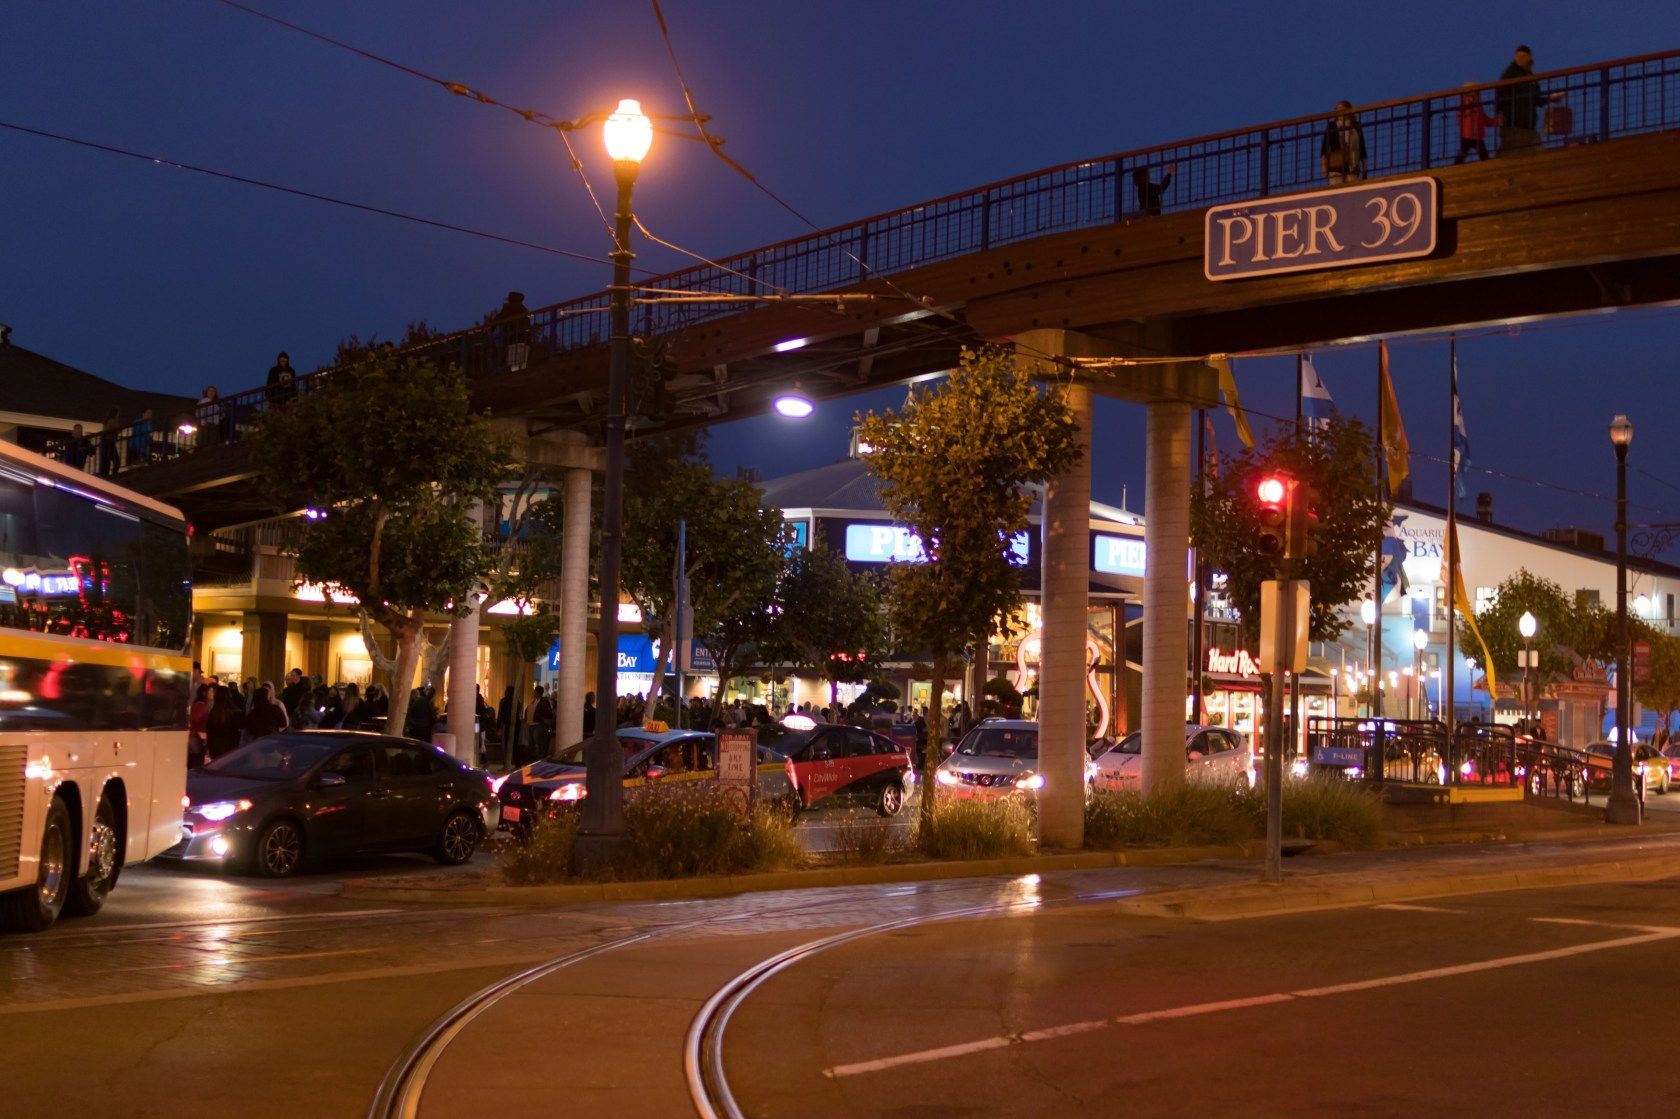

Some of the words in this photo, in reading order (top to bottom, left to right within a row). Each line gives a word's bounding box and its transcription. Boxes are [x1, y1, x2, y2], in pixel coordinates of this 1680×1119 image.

[1216, 204, 1344, 266] PIER
[1361, 192, 1423, 249] 39
[1400, 526, 1446, 539] AQUARIU
[870, 527, 924, 557] PIE
[617, 652, 638, 668] BAY
[1208, 648, 1239, 673] Hard
[720, 741, 729, 752] NO
[729, 753, 743, 762] ANY
[727, 763, 744, 772] TIME
